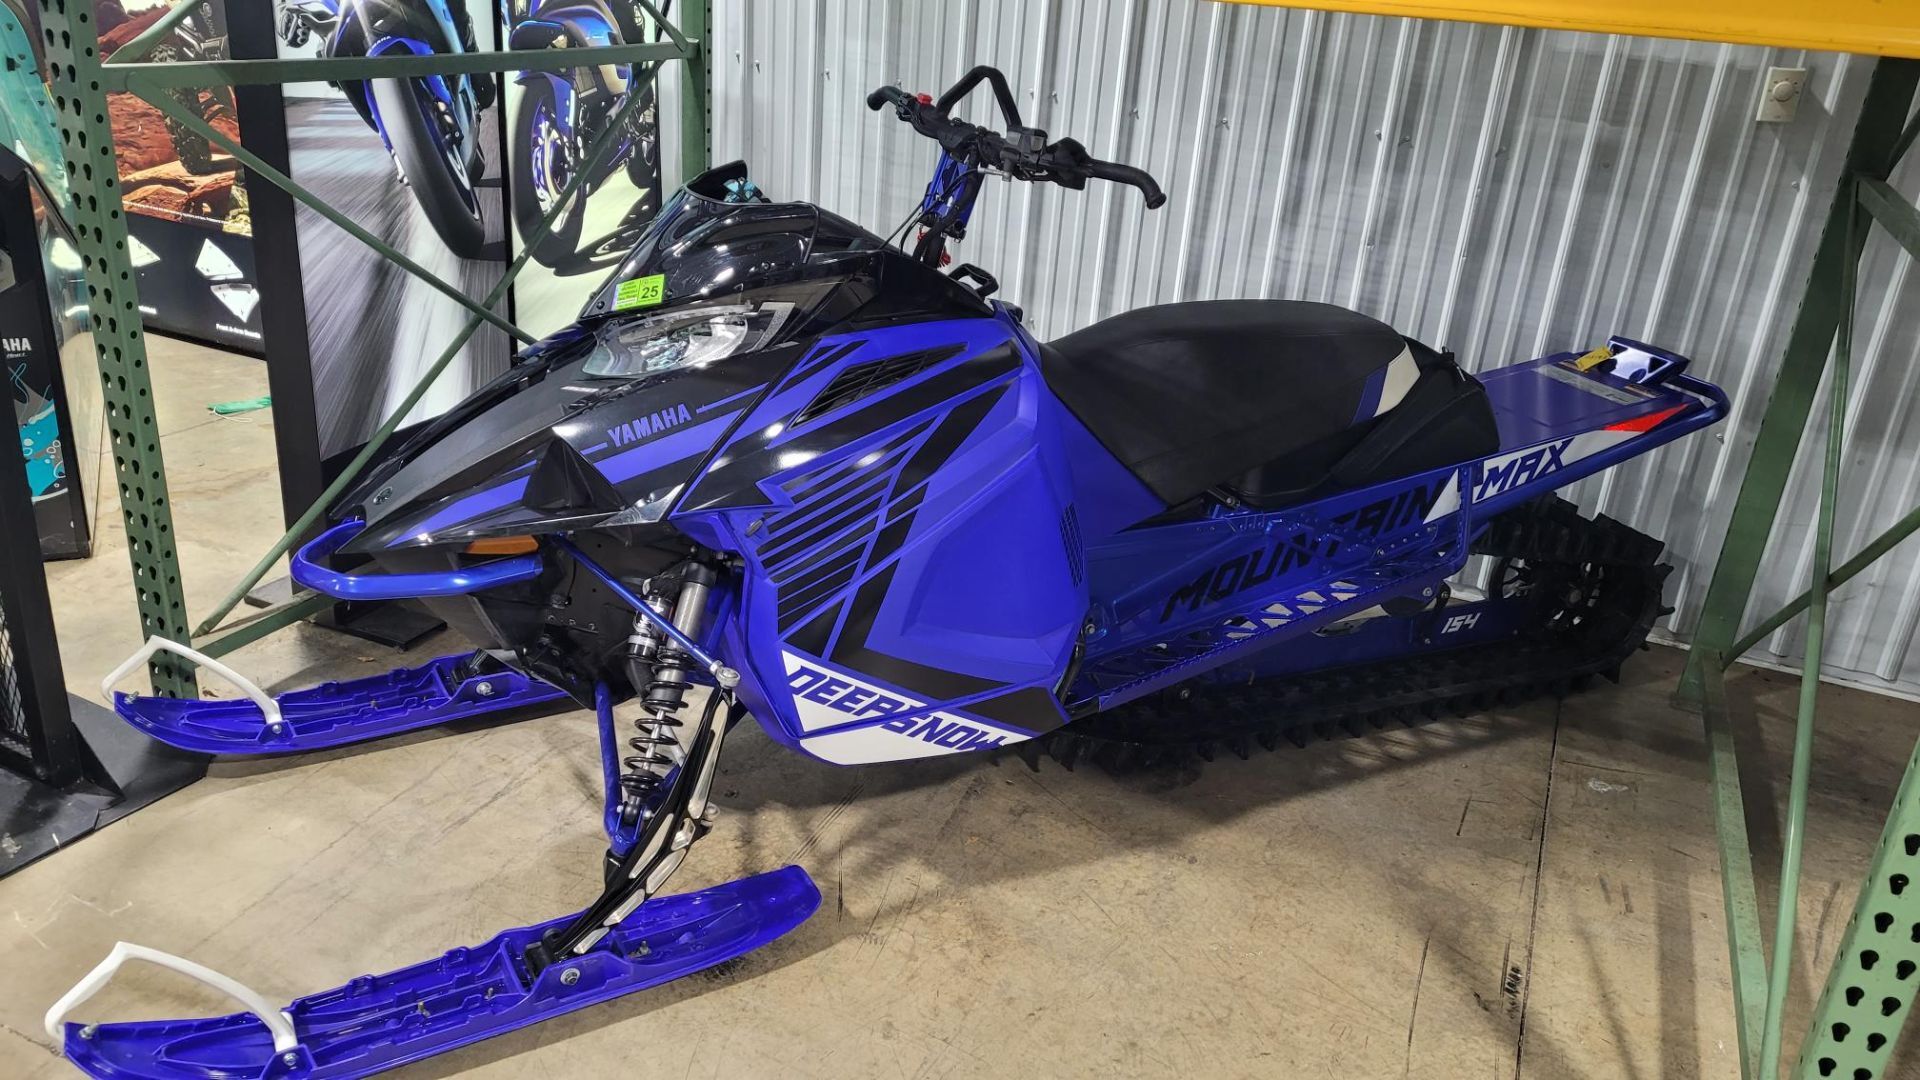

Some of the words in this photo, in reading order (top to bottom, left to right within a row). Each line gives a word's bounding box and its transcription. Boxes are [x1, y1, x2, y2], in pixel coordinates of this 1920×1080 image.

[641, 286, 659, 299] 25
[607, 403, 692, 448] YAMAHA
[1475, 437, 1576, 501] MAX
[1441, 612, 1481, 634] 154
